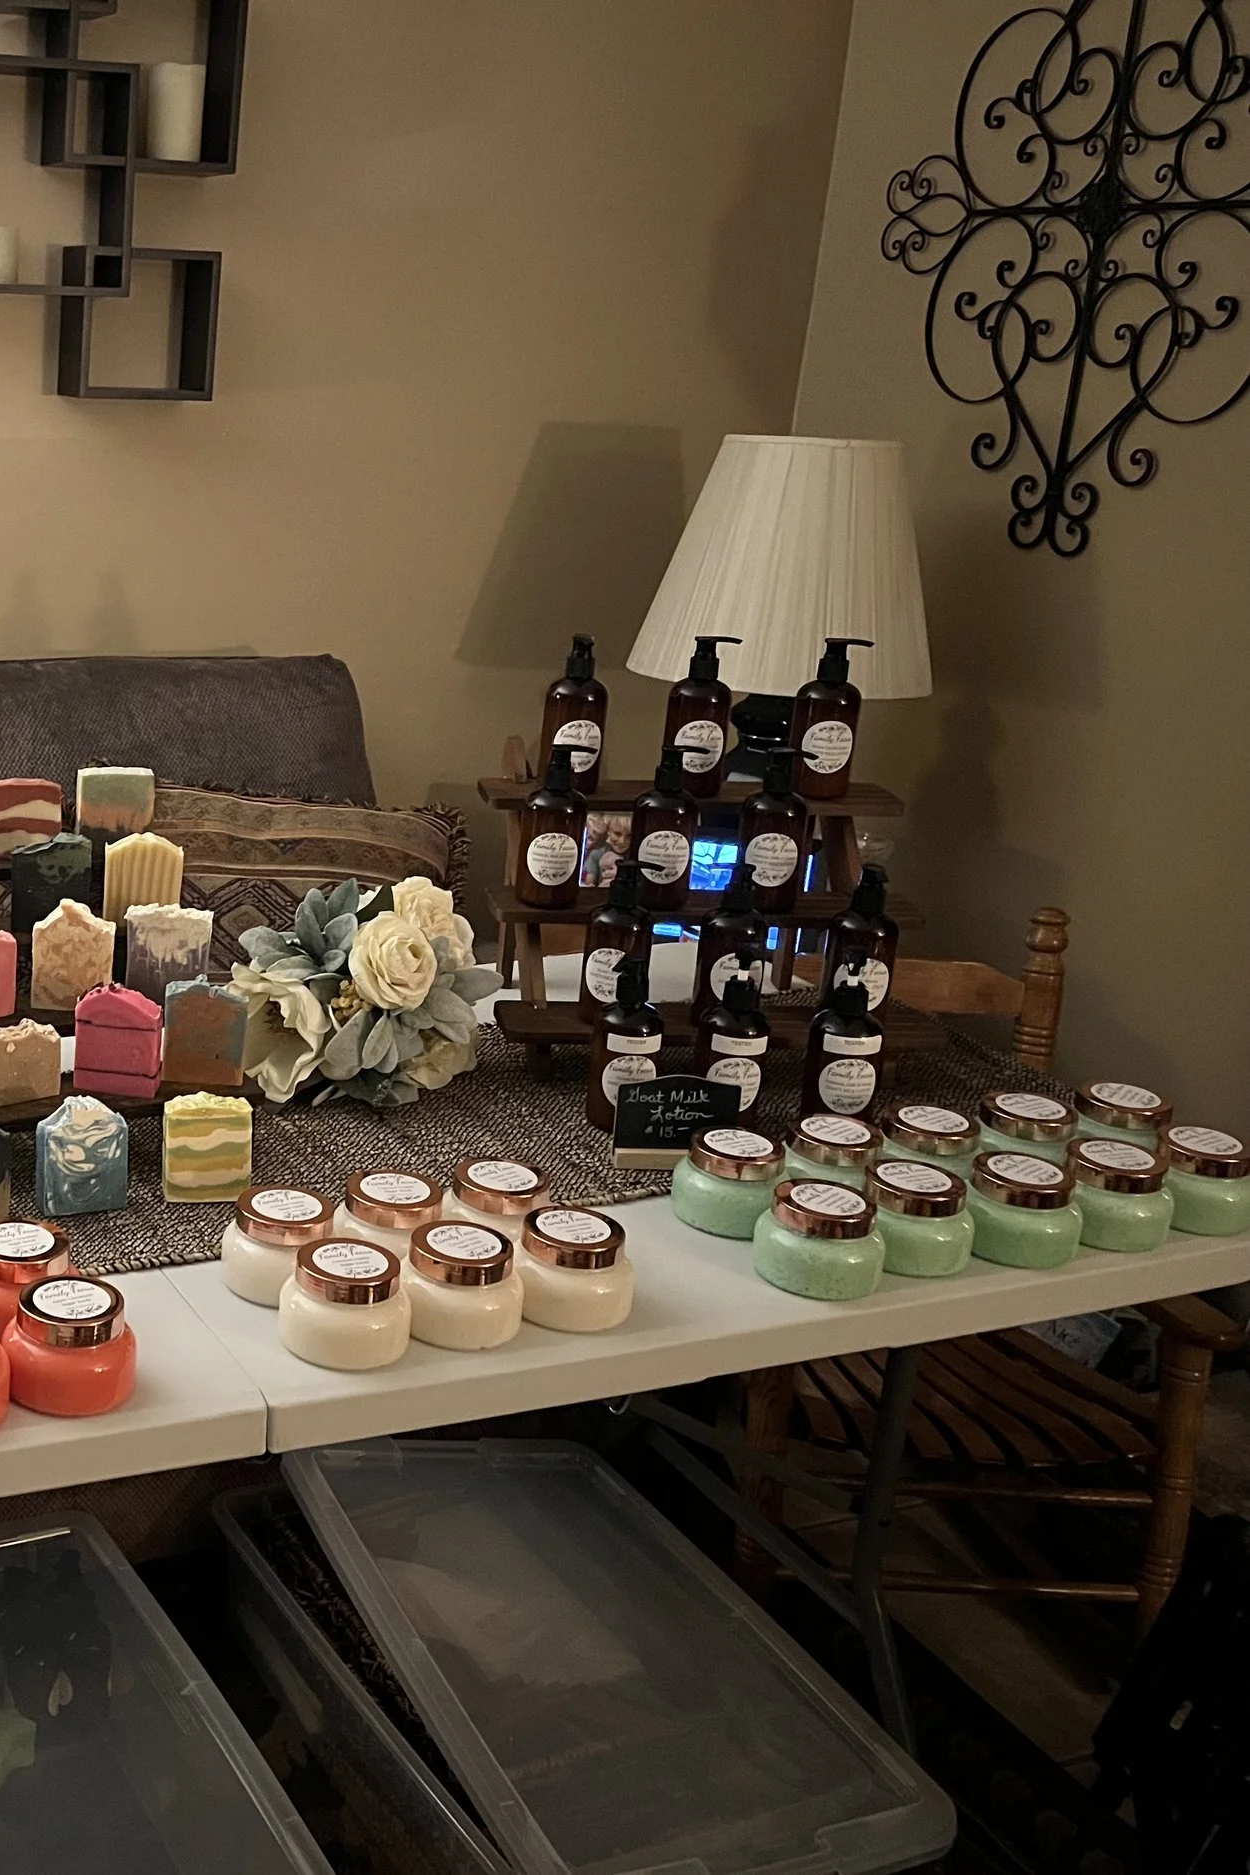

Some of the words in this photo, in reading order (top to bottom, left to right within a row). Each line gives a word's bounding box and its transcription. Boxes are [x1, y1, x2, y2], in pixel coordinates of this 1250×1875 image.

[626, 1087, 665, 1104] Goat
[670, 1089, 710, 1103] Milk
[650, 1106, 714, 1123] Lotion
